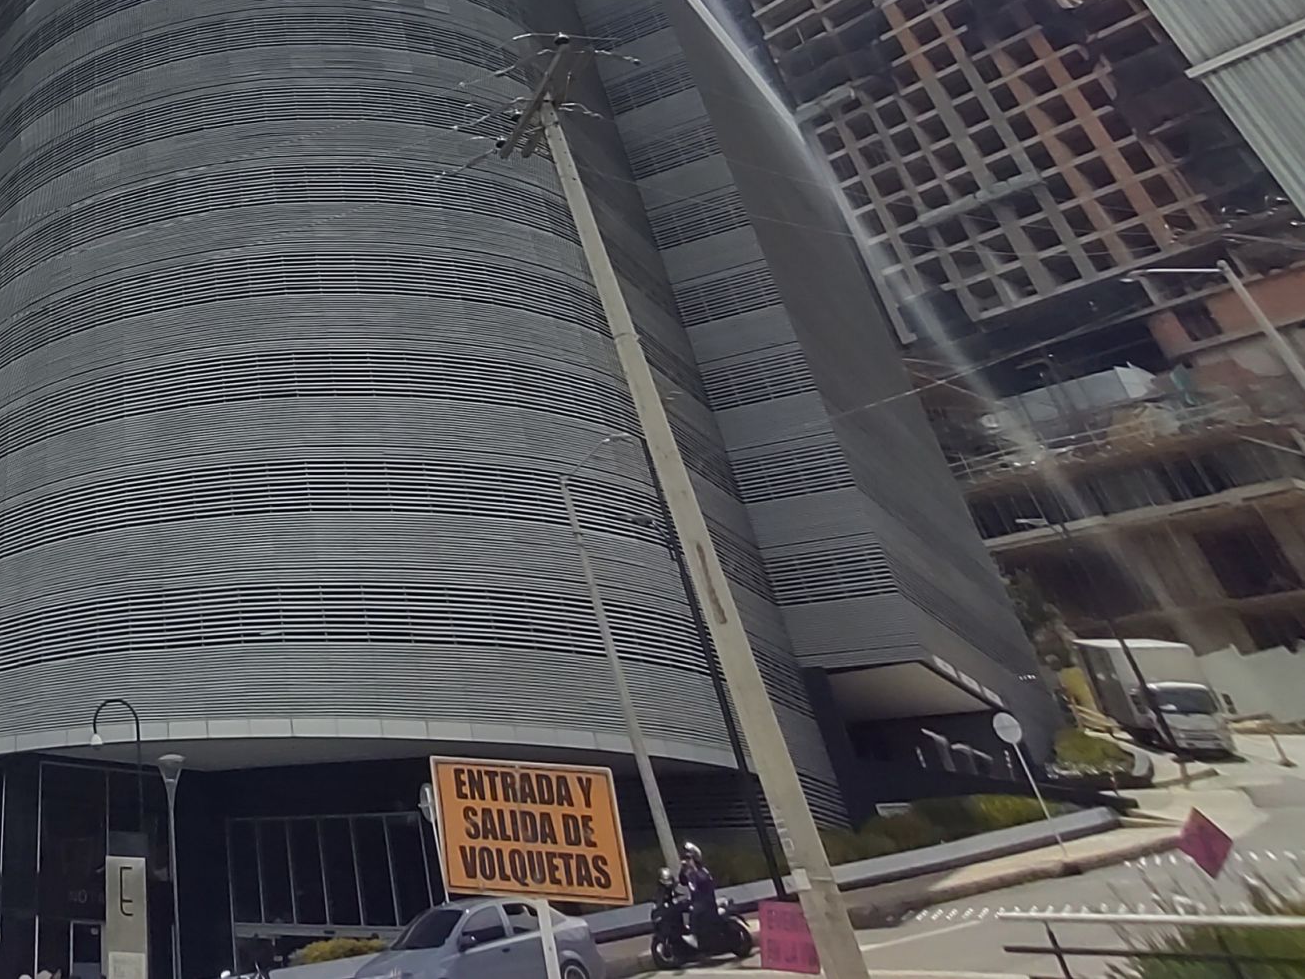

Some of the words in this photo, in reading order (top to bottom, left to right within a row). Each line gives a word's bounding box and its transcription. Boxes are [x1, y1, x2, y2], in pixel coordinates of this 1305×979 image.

[453, 768, 574, 807] ENTRADA
[577, 776, 592, 808] Y
[463, 806, 558, 845] SALIDA
[562, 813, 598, 848] DE
[459, 845, 612, 890] VOLQUETAS
